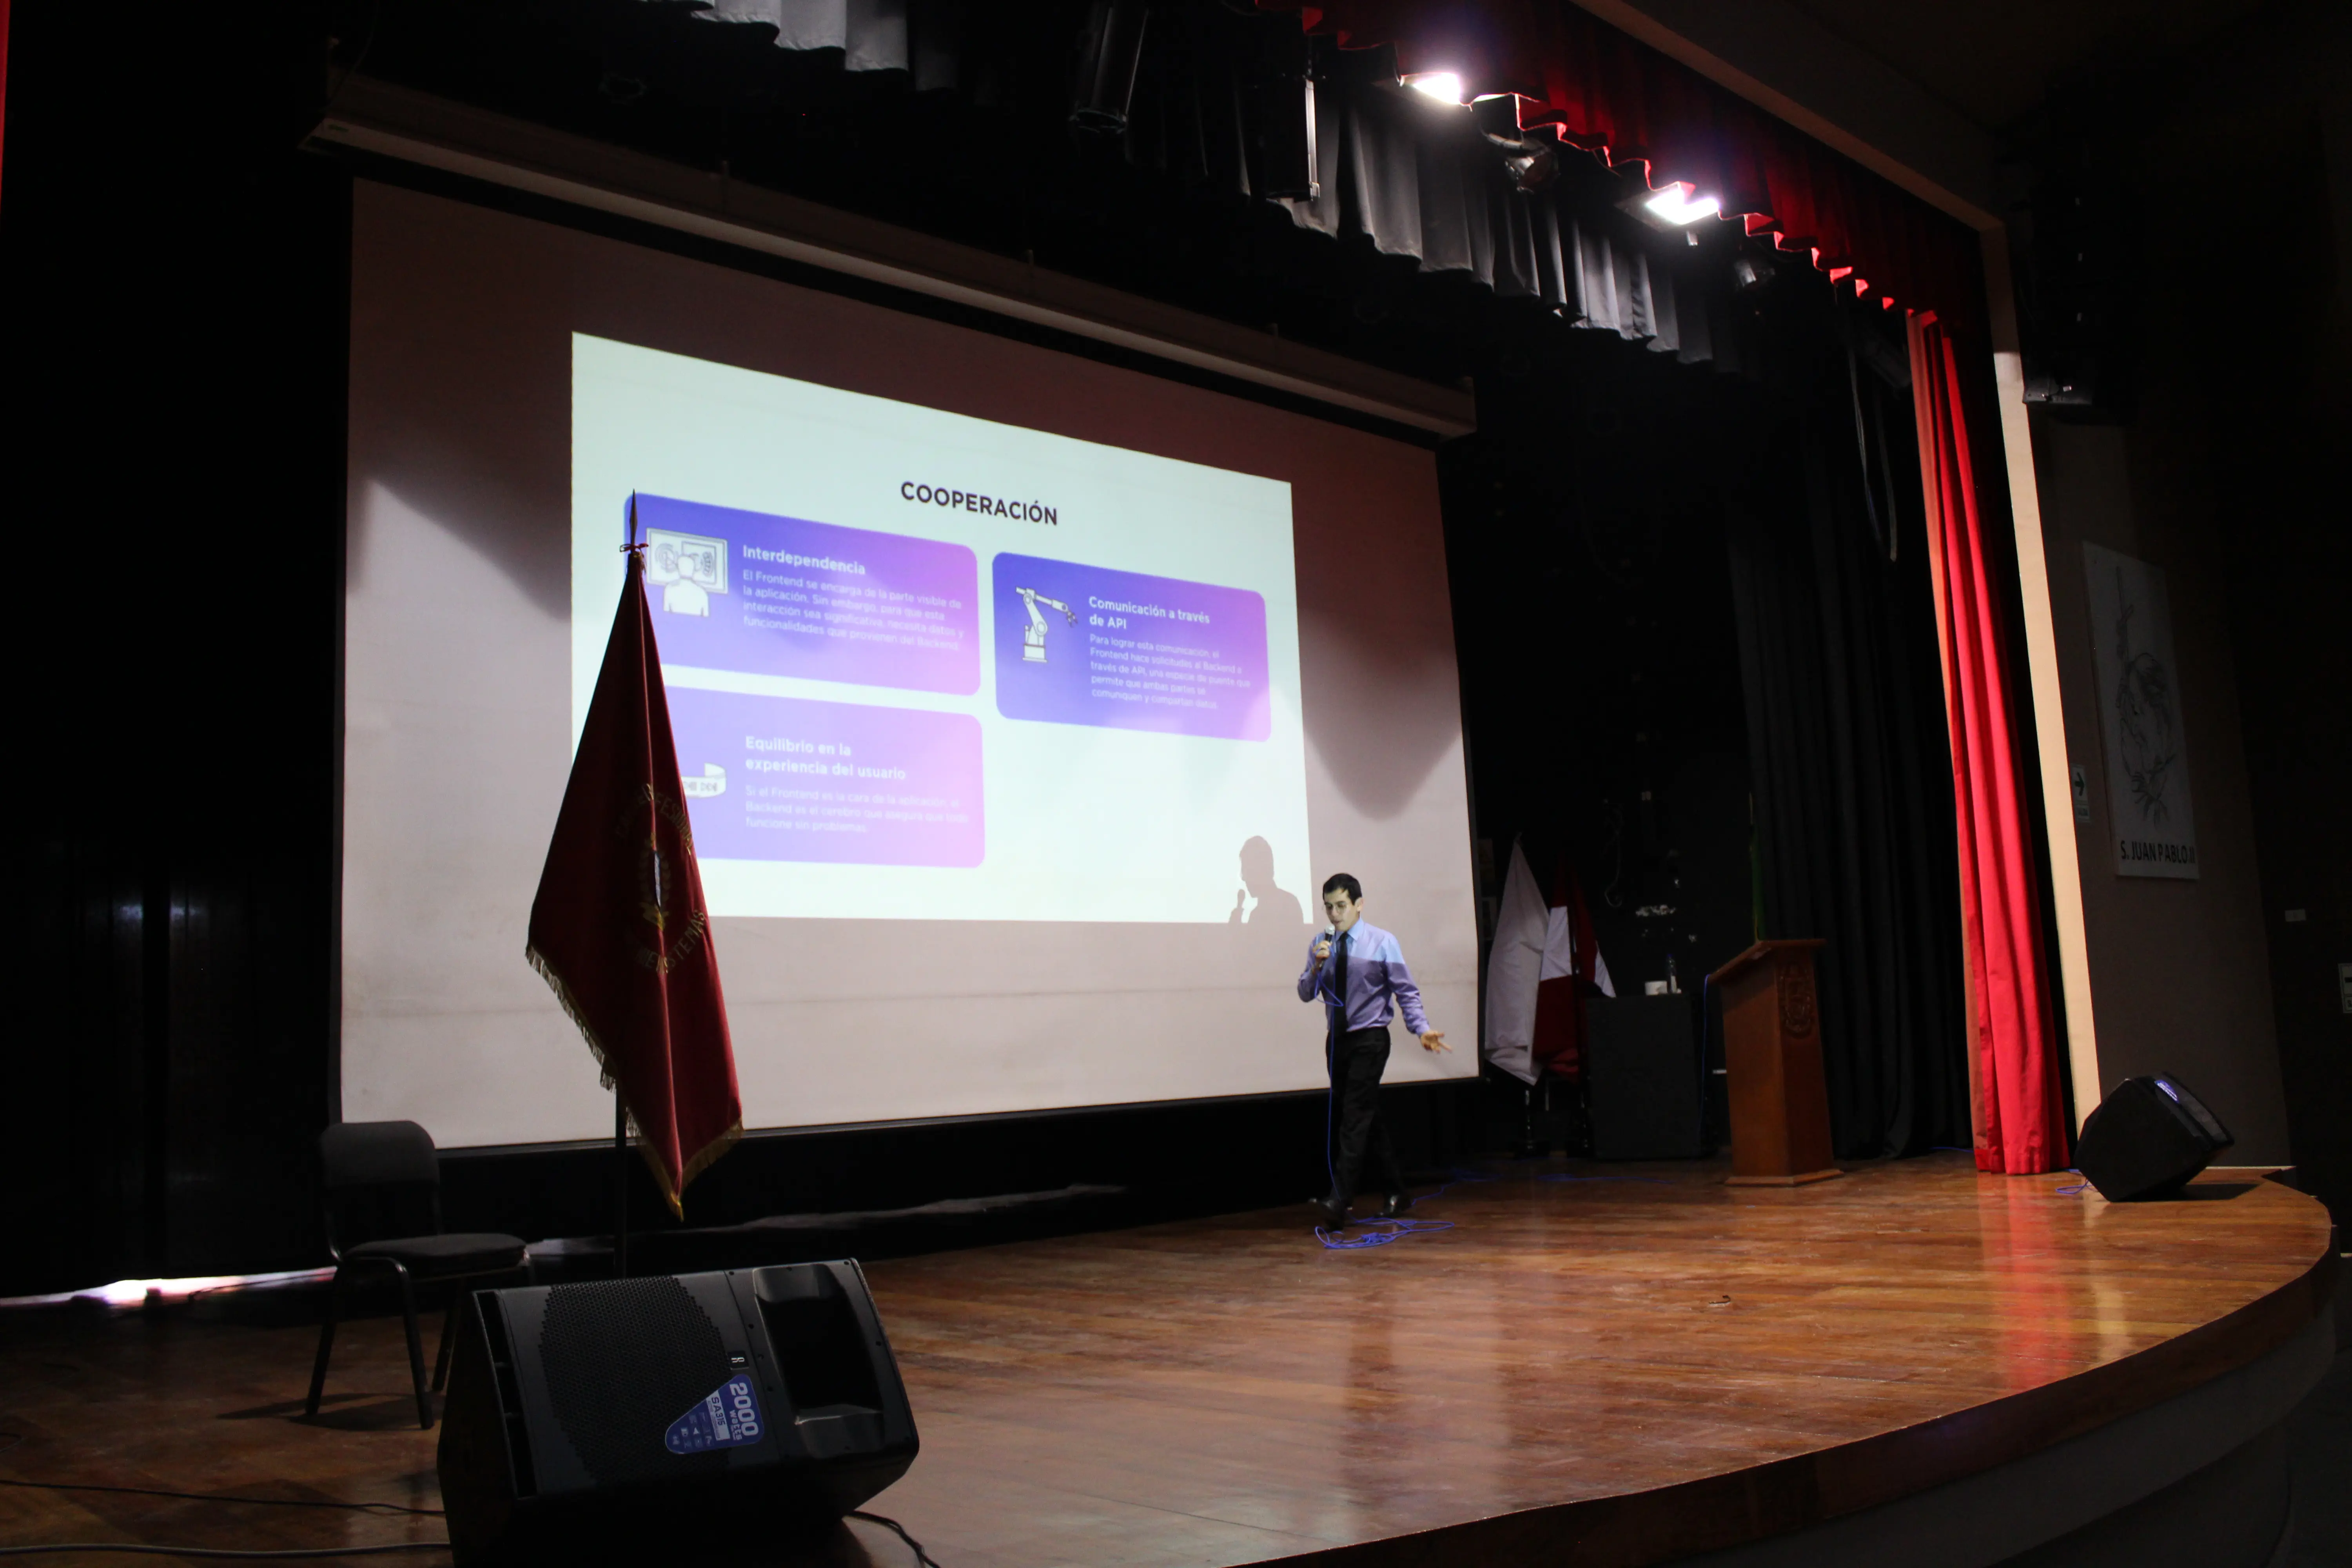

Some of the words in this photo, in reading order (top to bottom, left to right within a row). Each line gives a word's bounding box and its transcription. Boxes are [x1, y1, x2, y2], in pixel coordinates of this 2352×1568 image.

[901, 481, 1057, 526] COOPERACIÓN
[743, 544, 865, 575] Interdependencia
[743, 569, 753, 581] El
[756, 570, 803, 587] Frontend
[806, 581, 818, 590] se
[865, 588, 876, 597] de
[743, 585, 752, 595] la
[755, 588, 809, 603] aplicación.
[812, 594, 829, 605] Sin
[743, 601, 800, 616] interacción
[804, 609, 821, 619] sea
[958, 630, 964, 639] y
[1089, 596, 1166, 618] Comunicación
[1169, 610, 1175, 619] a
[1178, 609, 1210, 624] través
[744, 615, 824, 635] funcionalidades
[827, 628, 847, 638] que
[1089, 614, 1104, 626] de
[1107, 616, 1127, 630] API
[1090, 633, 1109, 645] Para
[1111, 637, 1135, 649] lograr
[1090, 647, 1129, 661] Frontend
[1091, 661, 1117, 673] través
[1118, 665, 1129, 673] de
[1149, 670, 1163, 678] una
[1091, 676, 1123, 687] permite
[1125, 680, 1141, 690] que
[1143, 681, 1169, 691] ambas
[1092, 689, 1142, 701] comuniquen
[1144, 695, 1149, 703] y
[746, 735, 814, 753] Equilibrio
[818, 744, 835, 755] en
[839, 742, 851, 756] la
[745, 758, 828, 775] experiencia
[832, 762, 853, 776] del
[857, 766, 906, 780] usuario
[746, 785, 755, 796] Si
[758, 786, 768, 797] el
[771, 787, 819, 800] Frontend
[822, 792, 833, 800] es
[836, 791, 845, 801] la
[848, 793, 869, 802] cara
[872, 793, 884, 804] de
[746, 801, 792, 814] Backend
[795, 806, 806, 814] es
[809, 805, 818, 815] el
[821, 806, 861, 817] cerebro
[864, 809, 882, 818] que
[746, 816, 792, 829] funcione
[795, 820, 809, 829] sin
[2120, 839, 2129, 860] S.
[2131, 840, 2156, 862] JUAN
[2158, 843, 2187, 864] PABLO
[2189, 846, 2196, 864] II
[711, 1397, 726, 1425] SA315
[729, 1382, 759, 1436] 2000
[730, 1410, 742, 1440] watts
